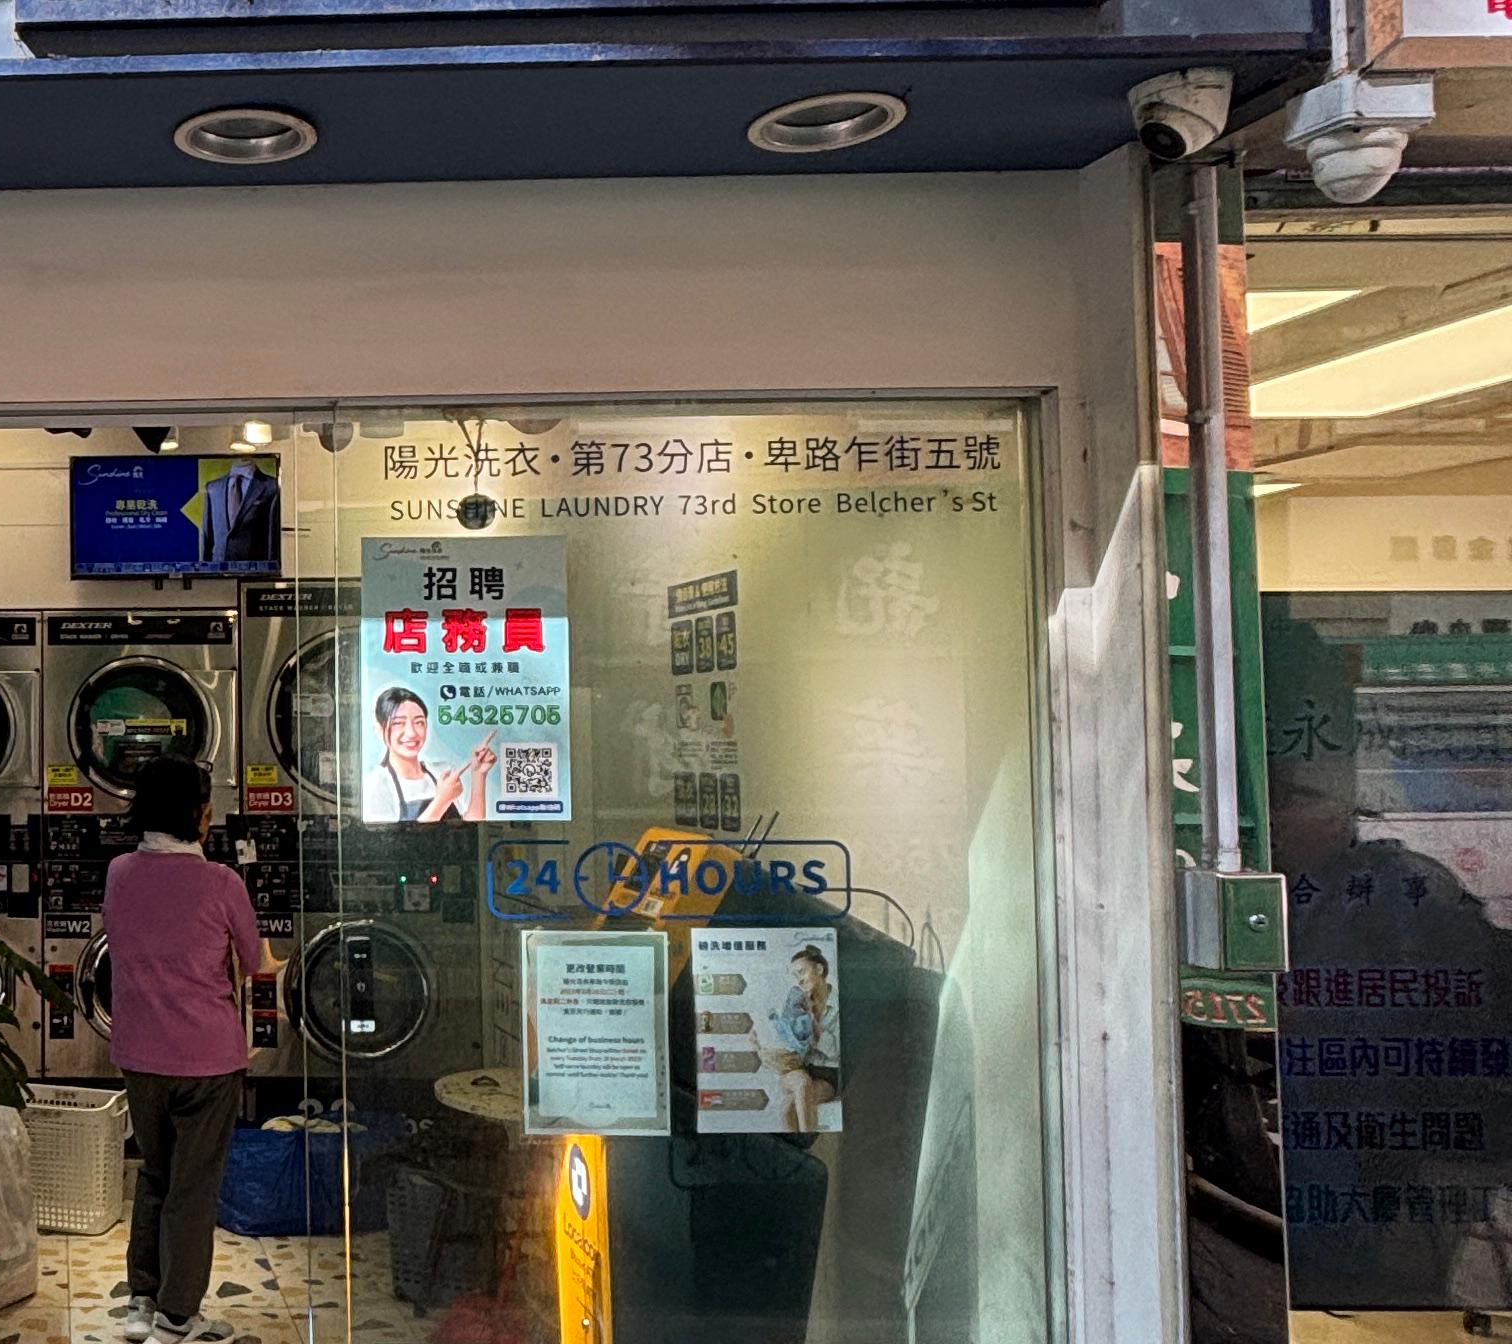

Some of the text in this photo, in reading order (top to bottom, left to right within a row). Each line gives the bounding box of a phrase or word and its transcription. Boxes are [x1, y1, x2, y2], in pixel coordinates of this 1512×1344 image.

[541, 495, 665, 518] LAUNDRY
[679, 492, 737, 516] 73rd
[752, 493, 822, 515] Store
[972, 491, 998, 513] St
[423, 566, 505, 601] 招聘
[60, 622, 113, 630] DEXTER
[383, 607, 546, 654] 店務員
[70, 792, 93, 807] D2
[270, 792, 293, 807] D3
[505, 858, 829, 897] 24 HOURS
[66, 920, 91, 933] W2
[268, 920, 293, 933] W3
[1280, 1037, 1512, 1078] 注區內可持續發
